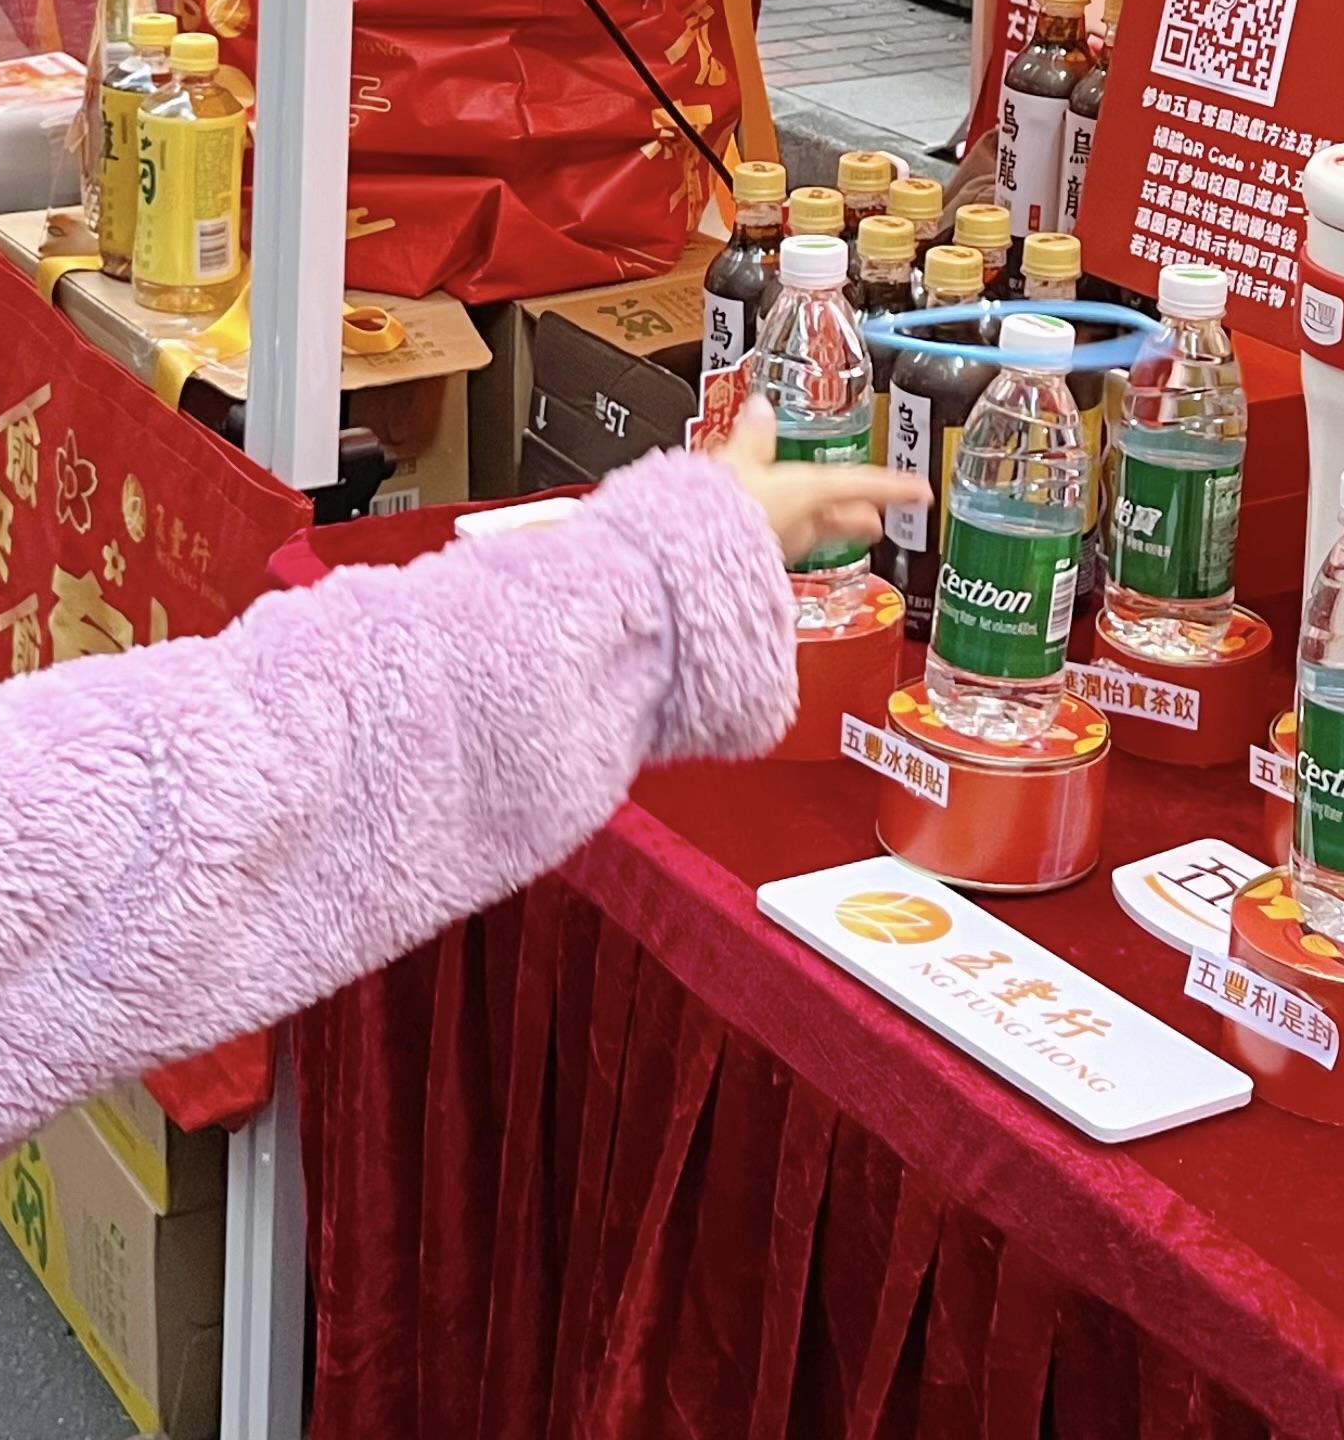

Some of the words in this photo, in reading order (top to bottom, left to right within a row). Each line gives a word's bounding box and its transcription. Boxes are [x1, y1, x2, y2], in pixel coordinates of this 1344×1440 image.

[844, 722, 946, 799] 五豐冰箱貼
[909, 961, 960, 990] NG
[954, 987, 1033, 1039] FUNG
[1025, 1038, 1119, 1096] HONG
[942, 950, 1113, 1040] 五豐行
[1192, 957, 1335, 1052] 五豐利是封
